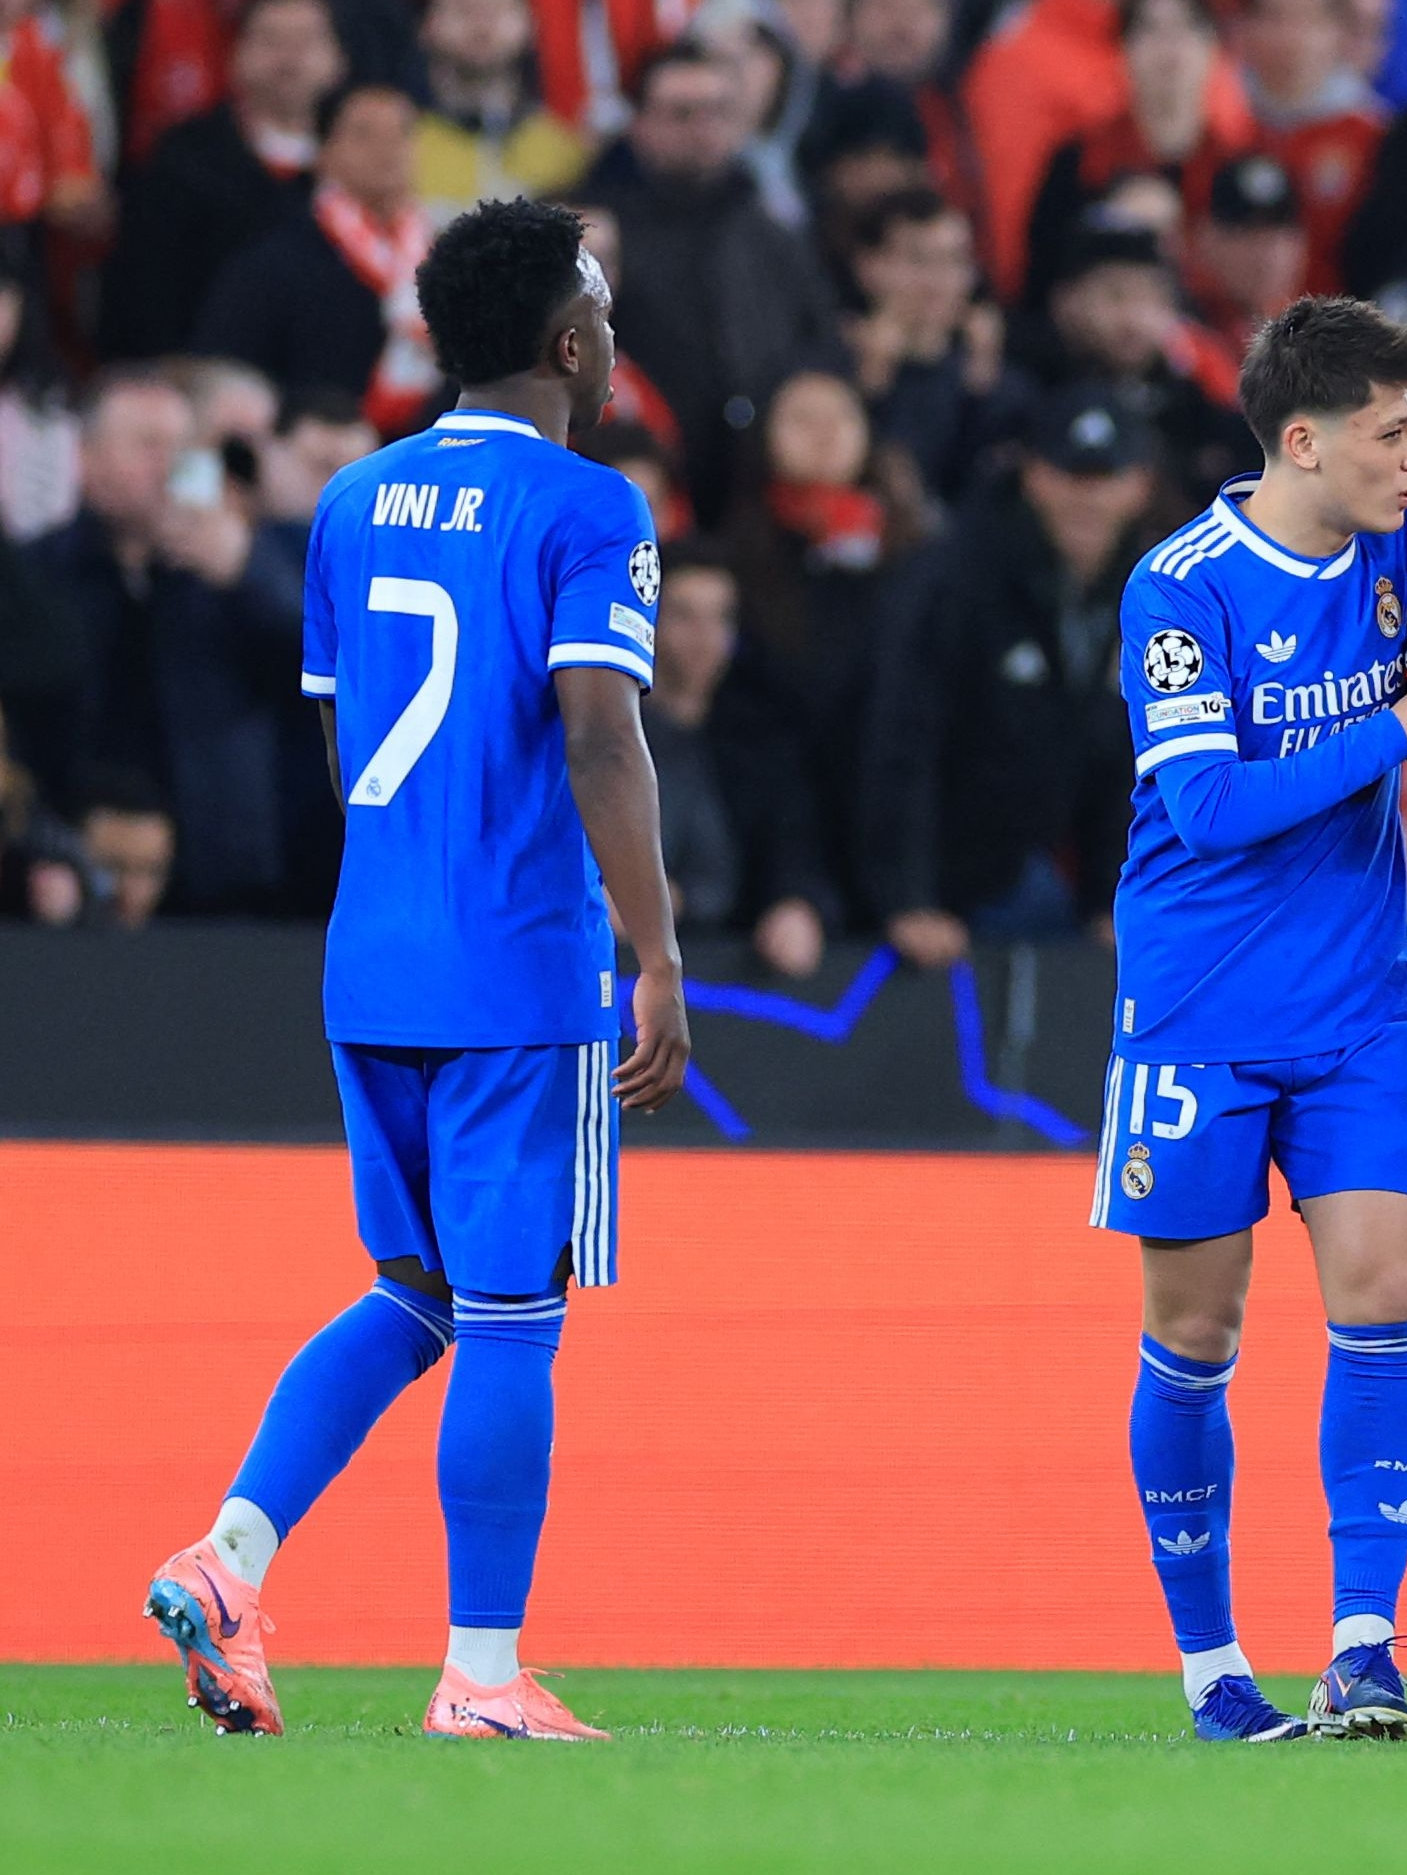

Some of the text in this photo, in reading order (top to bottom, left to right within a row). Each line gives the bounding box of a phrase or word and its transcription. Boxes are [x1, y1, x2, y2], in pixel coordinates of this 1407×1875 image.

[371, 483, 485, 533] VINI JR.
[1154, 646, 1187, 677] 15
[347, 576, 459, 807] 7
[1129, 1064, 1205, 1141] 15
[1145, 1483, 1218, 1504] RMCF
